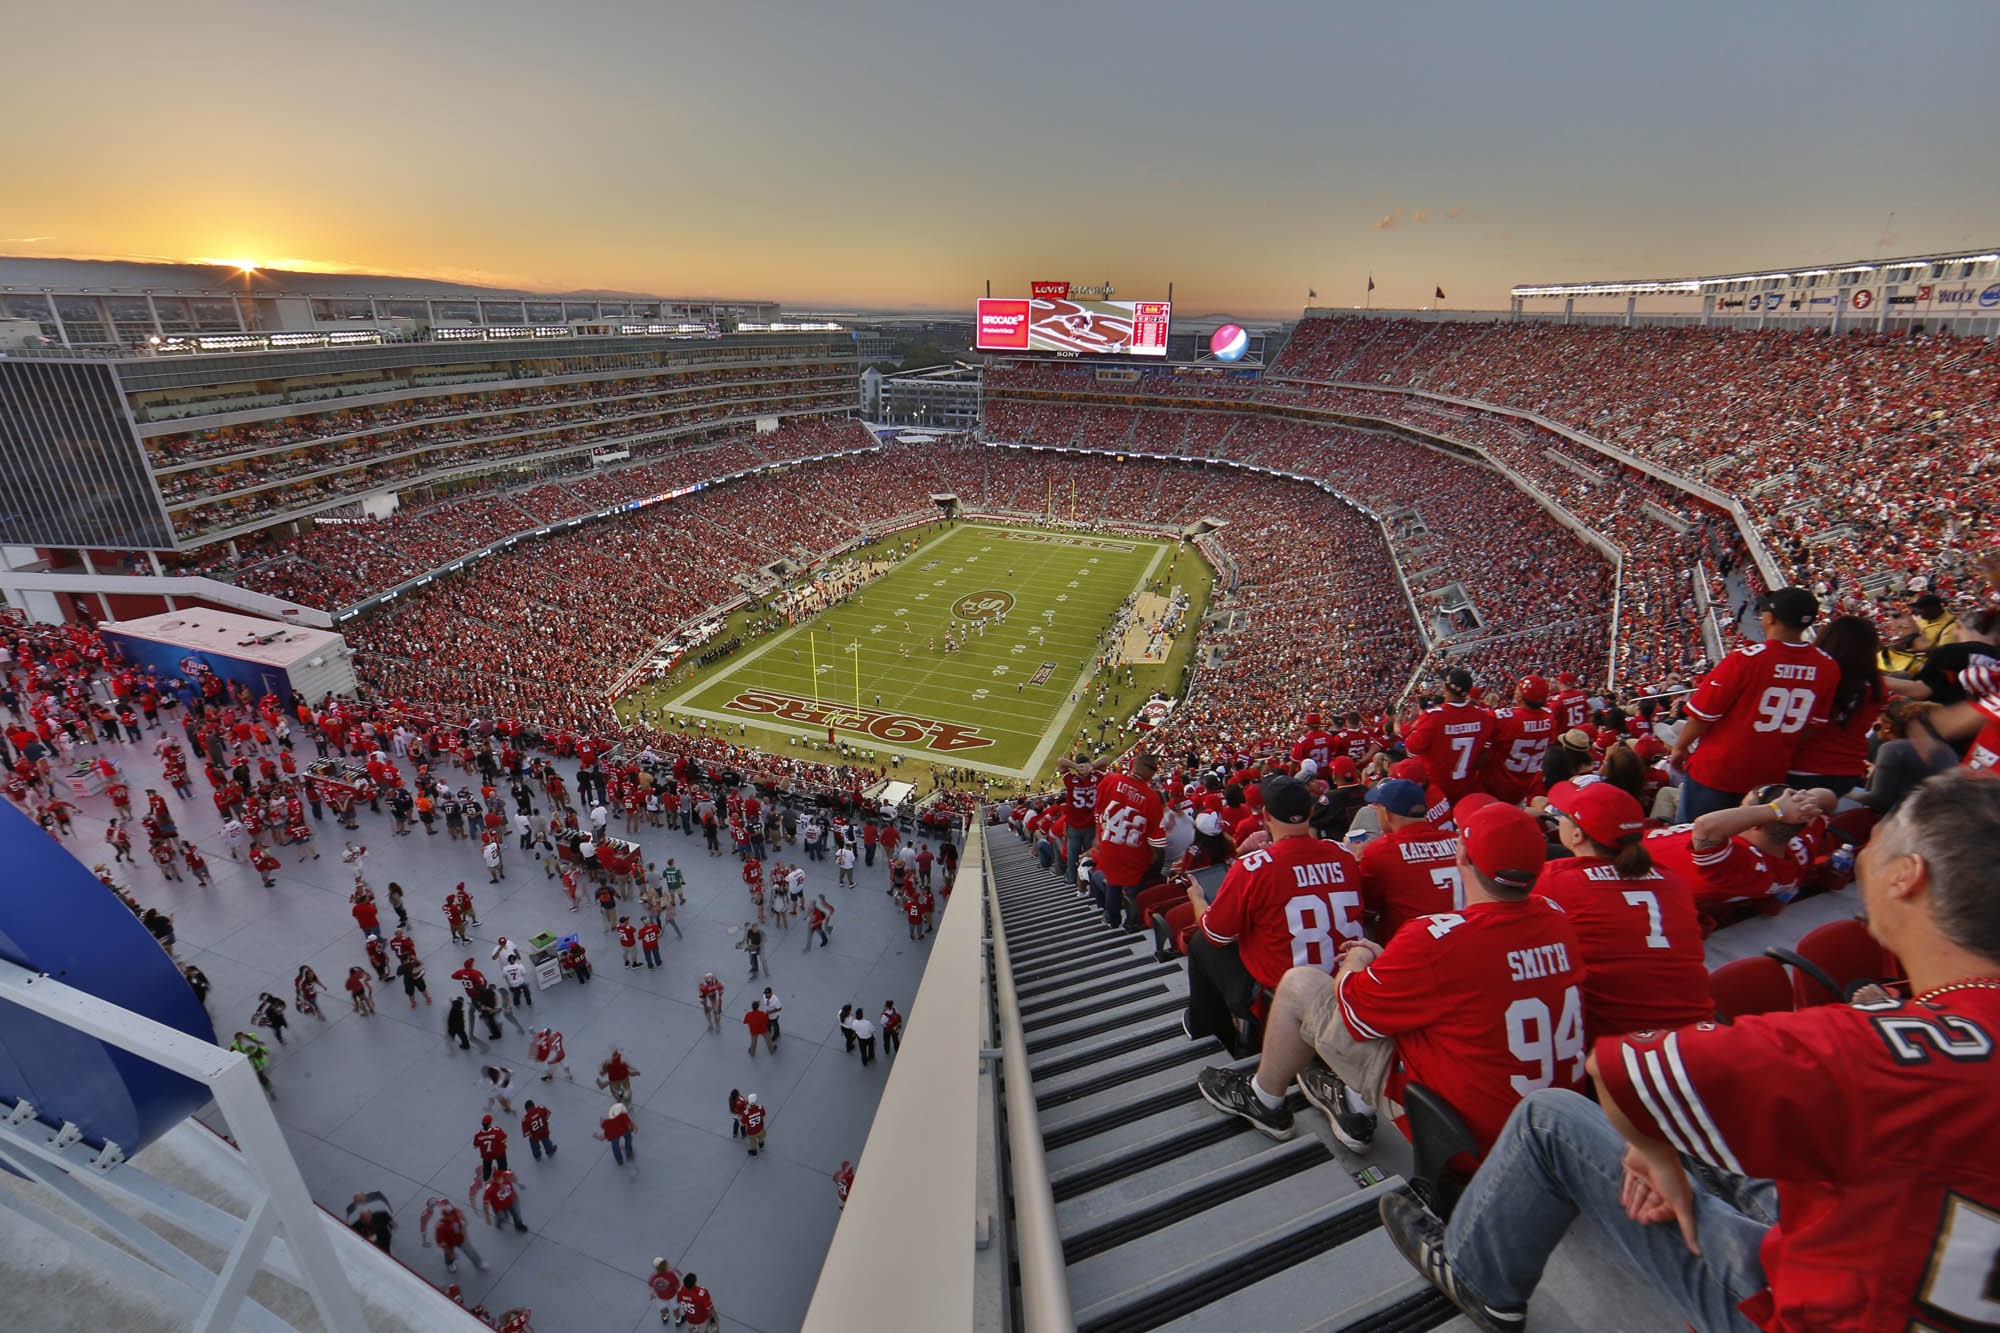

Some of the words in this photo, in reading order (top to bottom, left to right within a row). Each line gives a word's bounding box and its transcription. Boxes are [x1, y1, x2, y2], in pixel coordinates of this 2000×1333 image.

[982, 315, 1018, 325] BROCADE
[1773, 663, 1817, 681] SMITH
[1523, 718, 1551, 732] WILLIS
[1567, 705, 1584, 726] 15
[1753, 686, 1817, 733] 99
[1452, 737, 1475, 780] 7
[1505, 738, 1550, 773] 52
[1072, 786, 1098, 809] 53
[1426, 797, 1450, 822] YOUNG
[1293, 861, 1345, 888] DAVIS
[1430, 866, 1464, 911] 7
[1284, 891, 1364, 976] 85
[1622, 890, 1671, 948] 7
[1506, 942, 1570, 981] SMITH
[1505, 985, 1587, 1098] 94
[483, 1140, 492, 1152] 7
